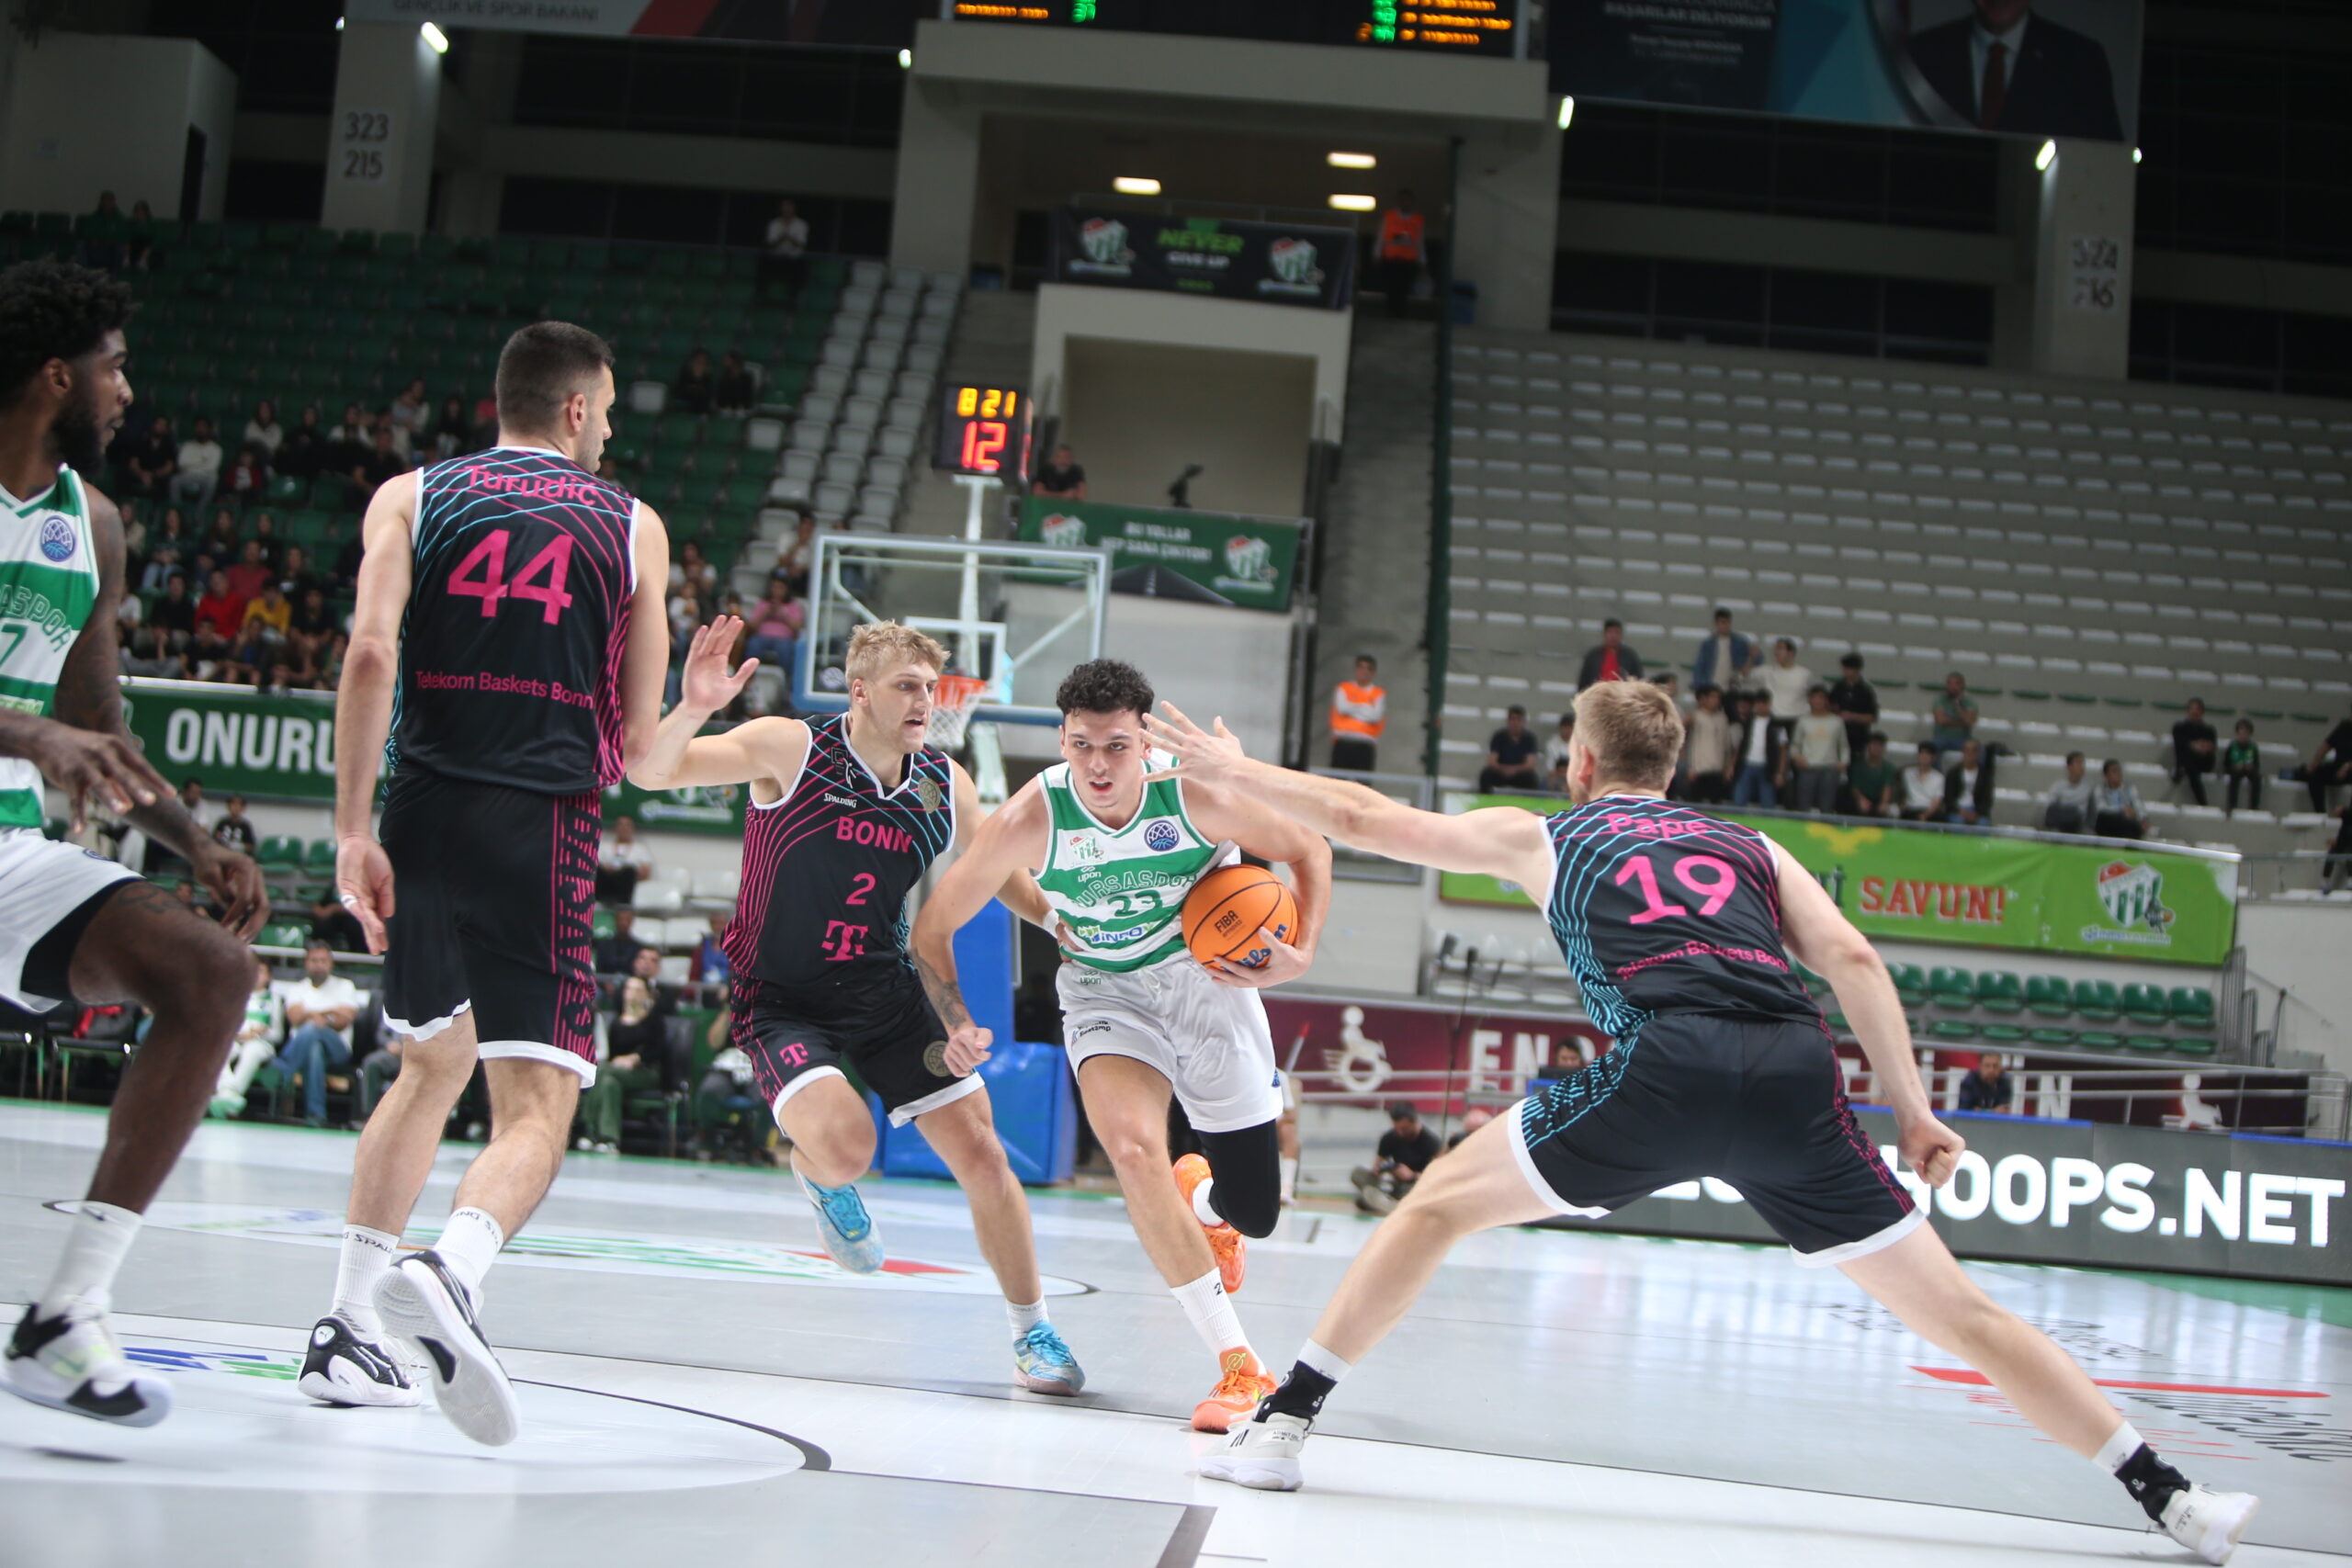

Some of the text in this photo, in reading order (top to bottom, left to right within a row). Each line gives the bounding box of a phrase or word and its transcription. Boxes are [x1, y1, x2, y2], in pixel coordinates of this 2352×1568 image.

[345, 111, 389, 141] 323
[344, 149, 383, 180] 215
[1156, 228, 1244, 254] NEVER
[961, 421, 1007, 471] 12
[447, 528, 573, 626] 44
[415, 671, 594, 710] Telekom Baskets Bonn
[823, 792, 858, 809] SPALDING
[836, 815, 913, 853] BONN
[1608, 812, 1711, 839] Pape
[845, 872, 876, 905] 2
[1078, 871, 1102, 883] upon
[1615, 854, 1736, 925] 19
[1107, 889, 1163, 917] 23
[1860, 875, 2008, 926] SAVUN!
[1214, 909, 1238, 933] FIBA
[1648, 1143, 2346, 1247] HOOPS.NET
